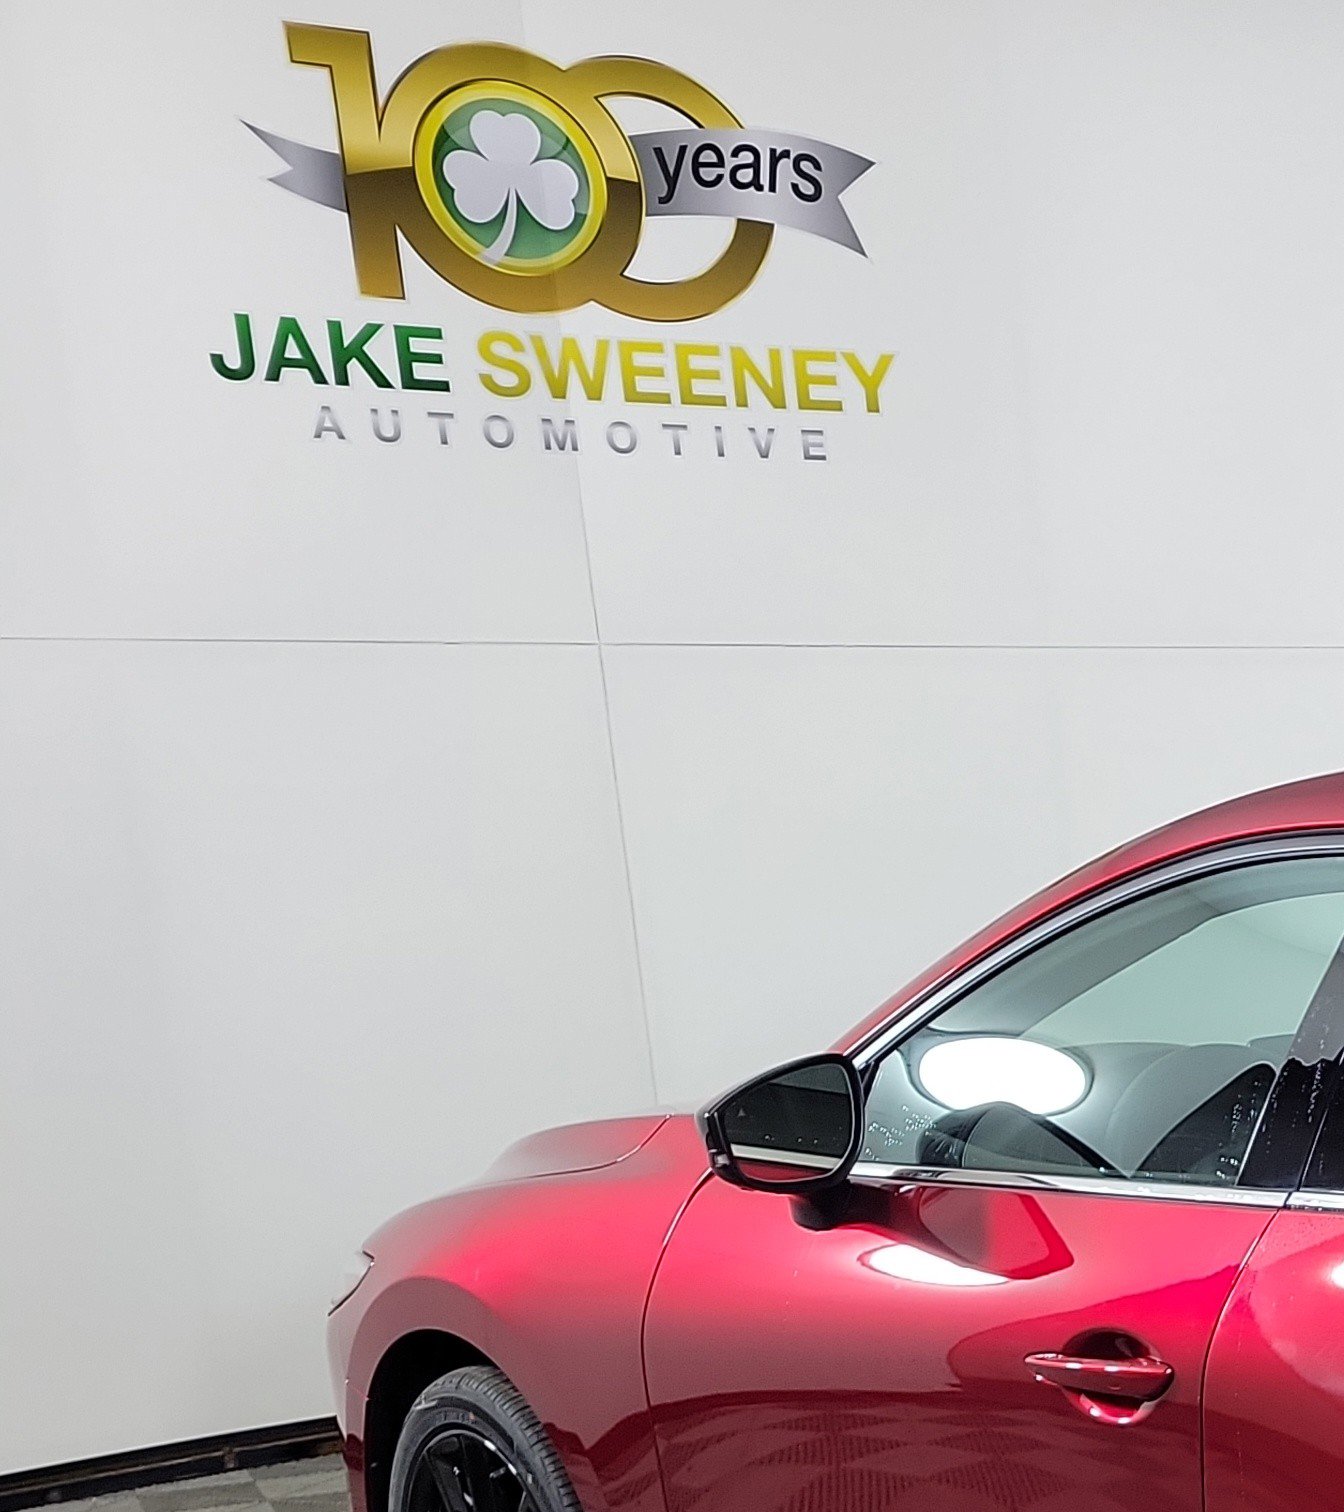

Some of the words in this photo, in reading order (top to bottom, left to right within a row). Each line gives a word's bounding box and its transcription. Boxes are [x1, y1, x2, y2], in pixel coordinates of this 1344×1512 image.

[281, 20, 775, 324] 100
[653, 140, 825, 205] years
[209, 312, 452, 393] JAKE
[476, 330, 895, 415] SWEENEY
[312, 405, 829, 463] AUTOMOTIVE
